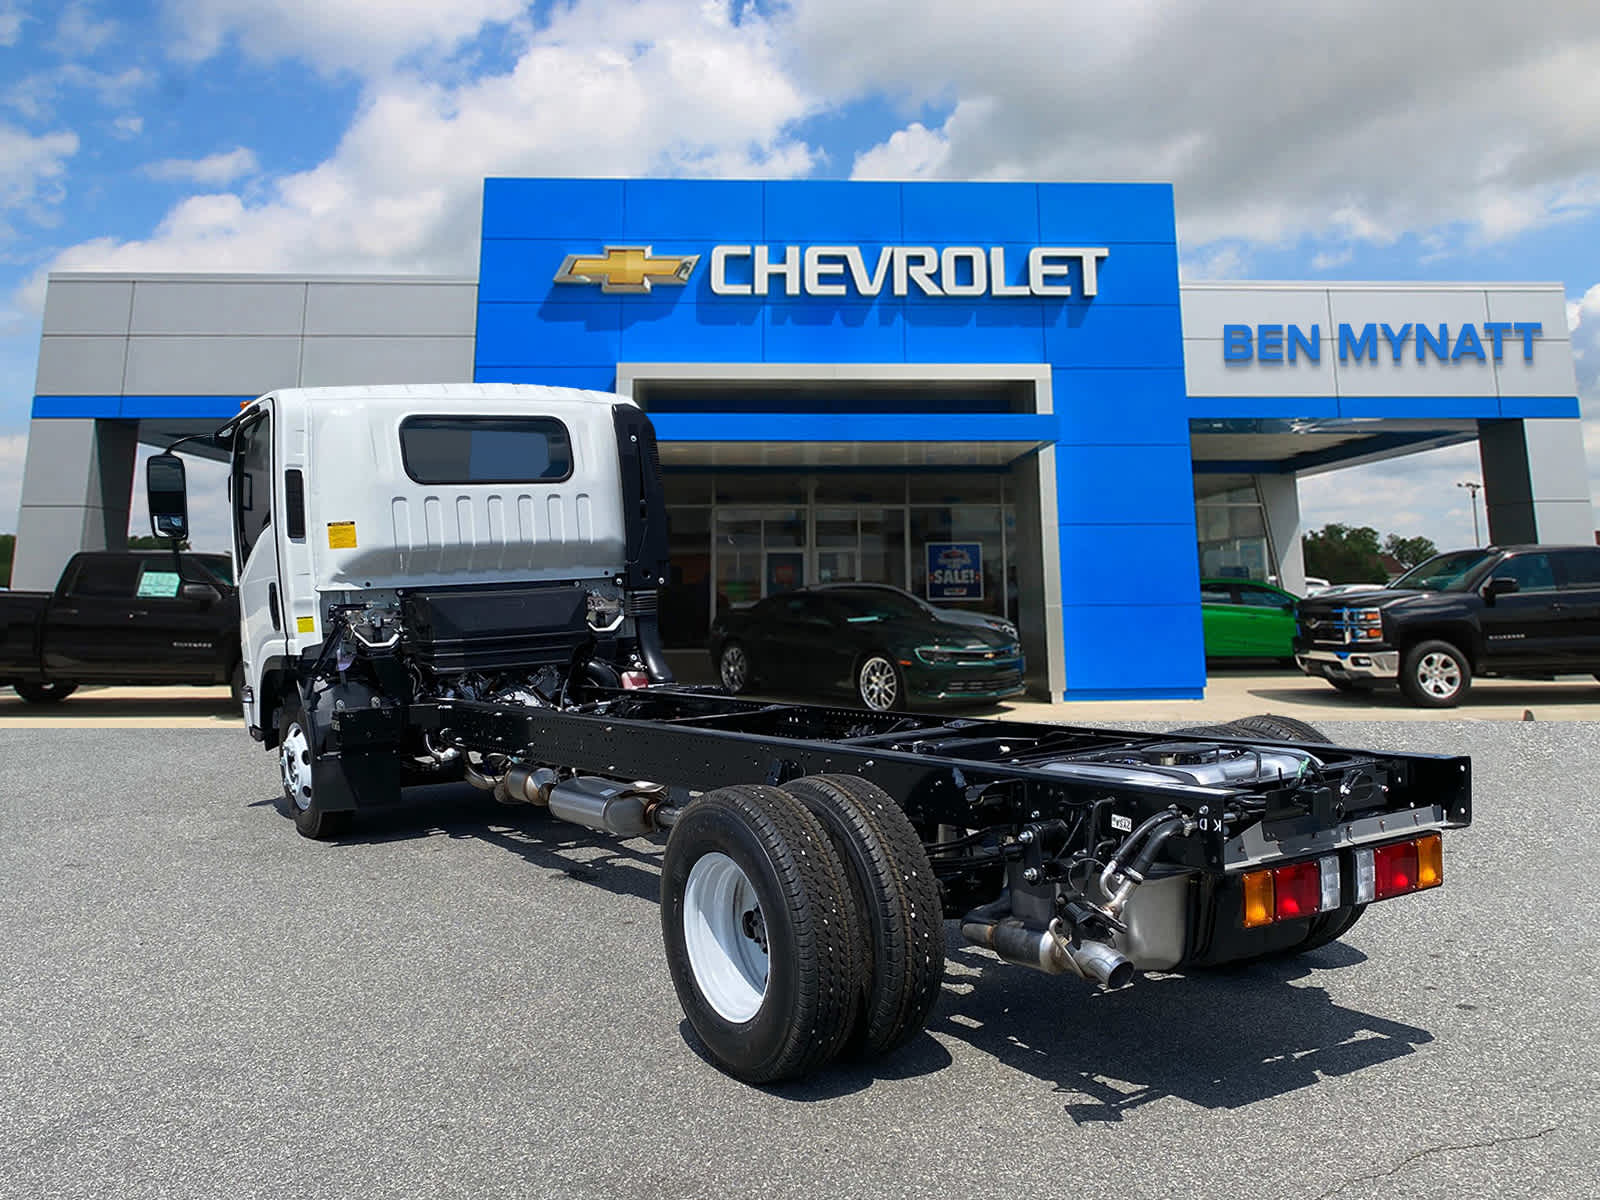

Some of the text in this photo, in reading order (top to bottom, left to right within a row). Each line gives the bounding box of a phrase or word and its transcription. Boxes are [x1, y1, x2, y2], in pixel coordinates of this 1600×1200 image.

[710, 245, 1109, 296] CHEVROLET
[1223, 322, 1542, 363] BEN MYNATT
[934, 568, 975, 584] SALE!
